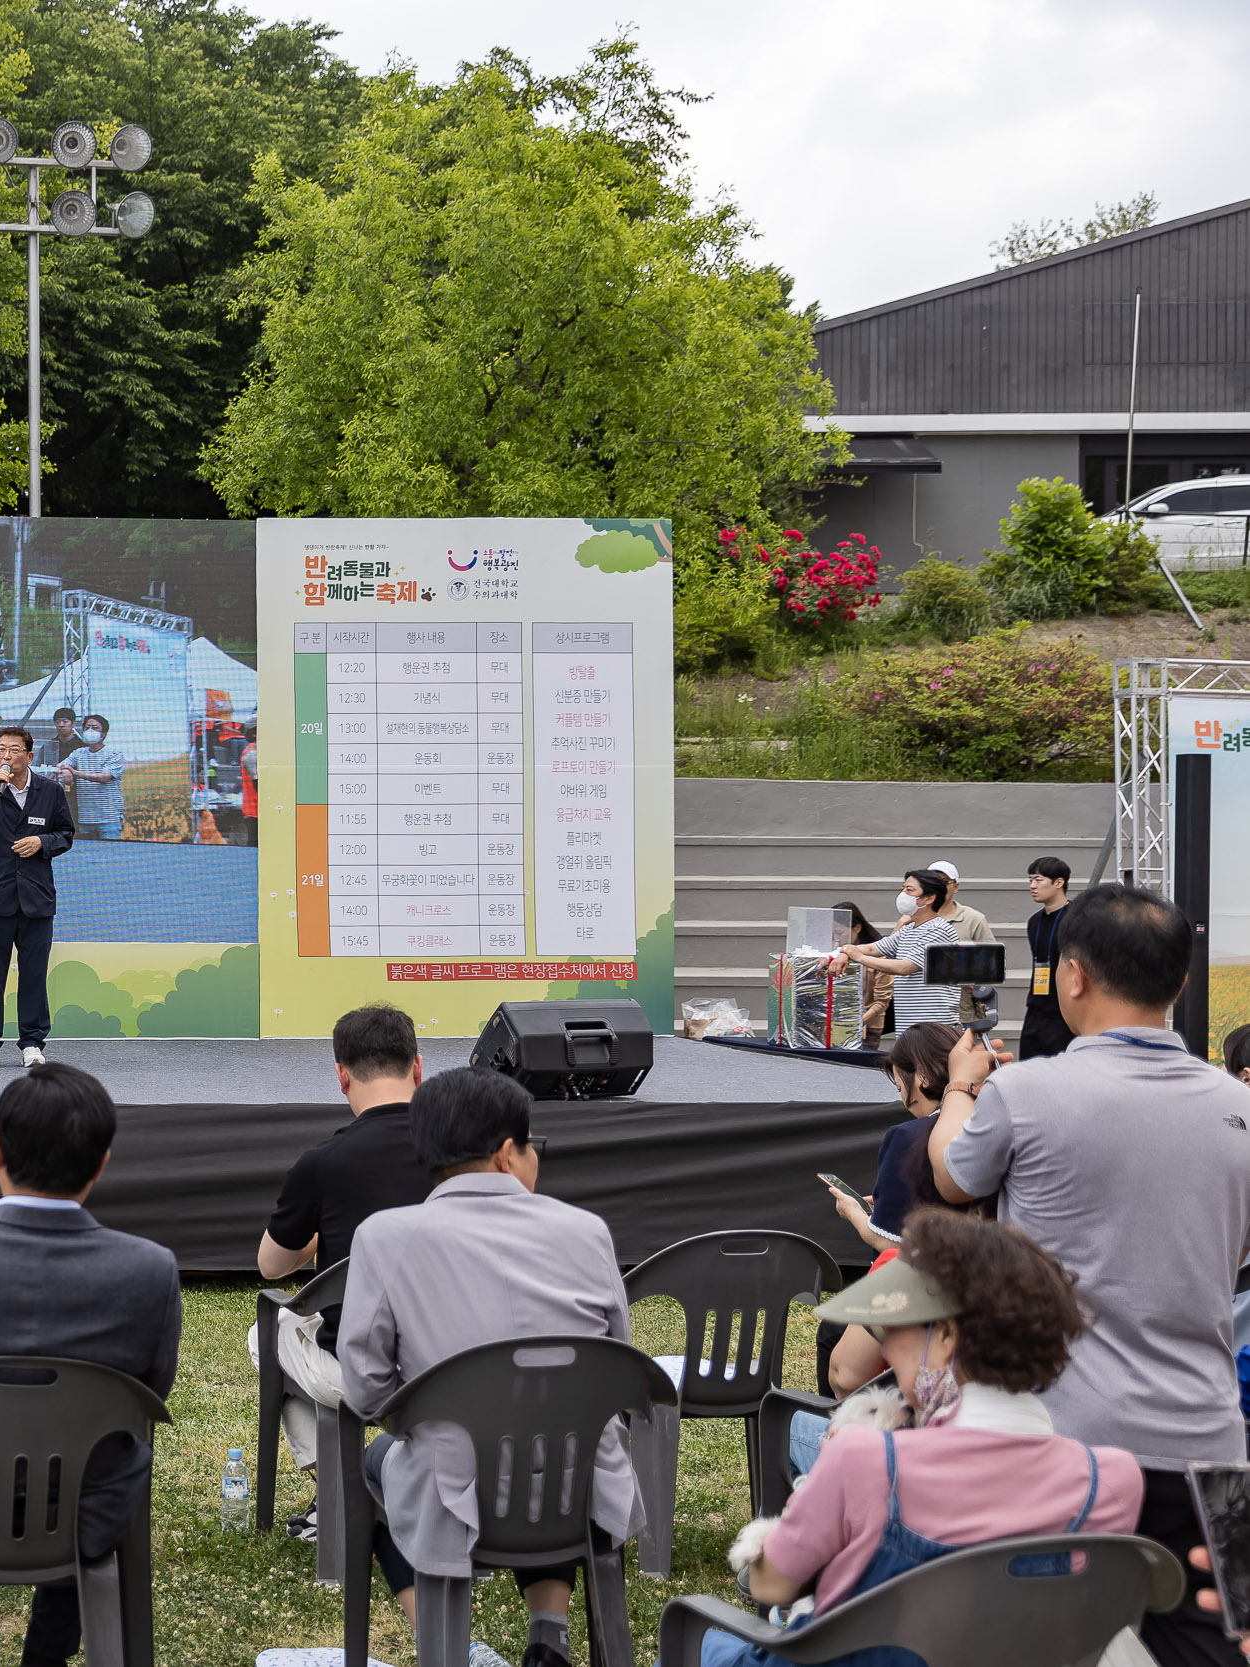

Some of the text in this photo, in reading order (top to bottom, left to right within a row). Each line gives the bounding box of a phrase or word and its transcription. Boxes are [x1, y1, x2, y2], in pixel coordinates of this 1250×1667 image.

[305, 554, 391, 582] 반려동물과
[482, 558, 518, 572] 행복광진
[473, 578, 518, 588] 건국대학교
[472, 590, 518, 600] 수의과대학
[332, 632, 370, 644] 시작시간
[406, 632, 446, 644] 행사 내용
[490, 632, 508, 644] 장소
[556, 632, 610, 644] 상시프로그램
[338, 662, 366, 674] 12:20
[402, 662, 451, 674] 행운권 추첨
[490, 662, 508, 674] 무대
[568, 666, 596, 680] 방탈출
[338, 692, 366, 704] 12:30
[414, 692, 441, 704] 기념식
[490, 692, 509, 704] 무대
[554, 690, 611, 704] 신분증 만들기
[555, 714, 612, 727] 커플템 만들기
[300, 722, 324, 735] 20일
[338, 722, 366, 734] 13:00
[417, 722, 470, 734] 동물행복상담소
[490, 722, 510, 734] 무대
[552, 736, 616, 750] 추억사진 꾸미기
[339, 752, 367, 764] 14:00
[414, 752, 442, 765] 운동회
[486, 752, 514, 765] 운동장
[552, 760, 616, 774] 로프토이 만들기
[340, 783, 367, 794] 15:00
[414, 782, 442, 795] 이벤트
[492, 782, 510, 794] 무대
[560, 784, 608, 799] 야바위 게임
[340, 814, 367, 825] 11:55
[404, 812, 452, 826] 행운권 추첨
[492, 812, 510, 825] 무대
[556, 808, 612, 822] 응급처치 교육
[566, 832, 602, 846] 플리마켓
[340, 844, 367, 855] 12:00
[418, 844, 437, 856] 빙고
[486, 843, 514, 856] 운동장
[556, 855, 612, 870] 갱얼쥐 올림픽
[302, 874, 324, 886] 21일
[340, 874, 368, 886] 12:45
[382, 874, 474, 886] 무궁화꽃이 피었습니다
[487, 873, 515, 886] 운동장
[558, 880, 611, 894] 무료기초미용
[340, 905, 368, 916] 14:00
[406, 904, 452, 917] 캐니크로스
[488, 904, 516, 916] 운동장
[566, 904, 602, 918] 행동상담
[576, 928, 594, 940] 타로
[342, 936, 369, 947] 15:45
[406, 934, 453, 948] 쿠킹클래스
[488, 934, 516, 947] 운동장
[390, 962, 634, 980] 붉은색 글씨 프로그램은 현장접수처에서 신청
